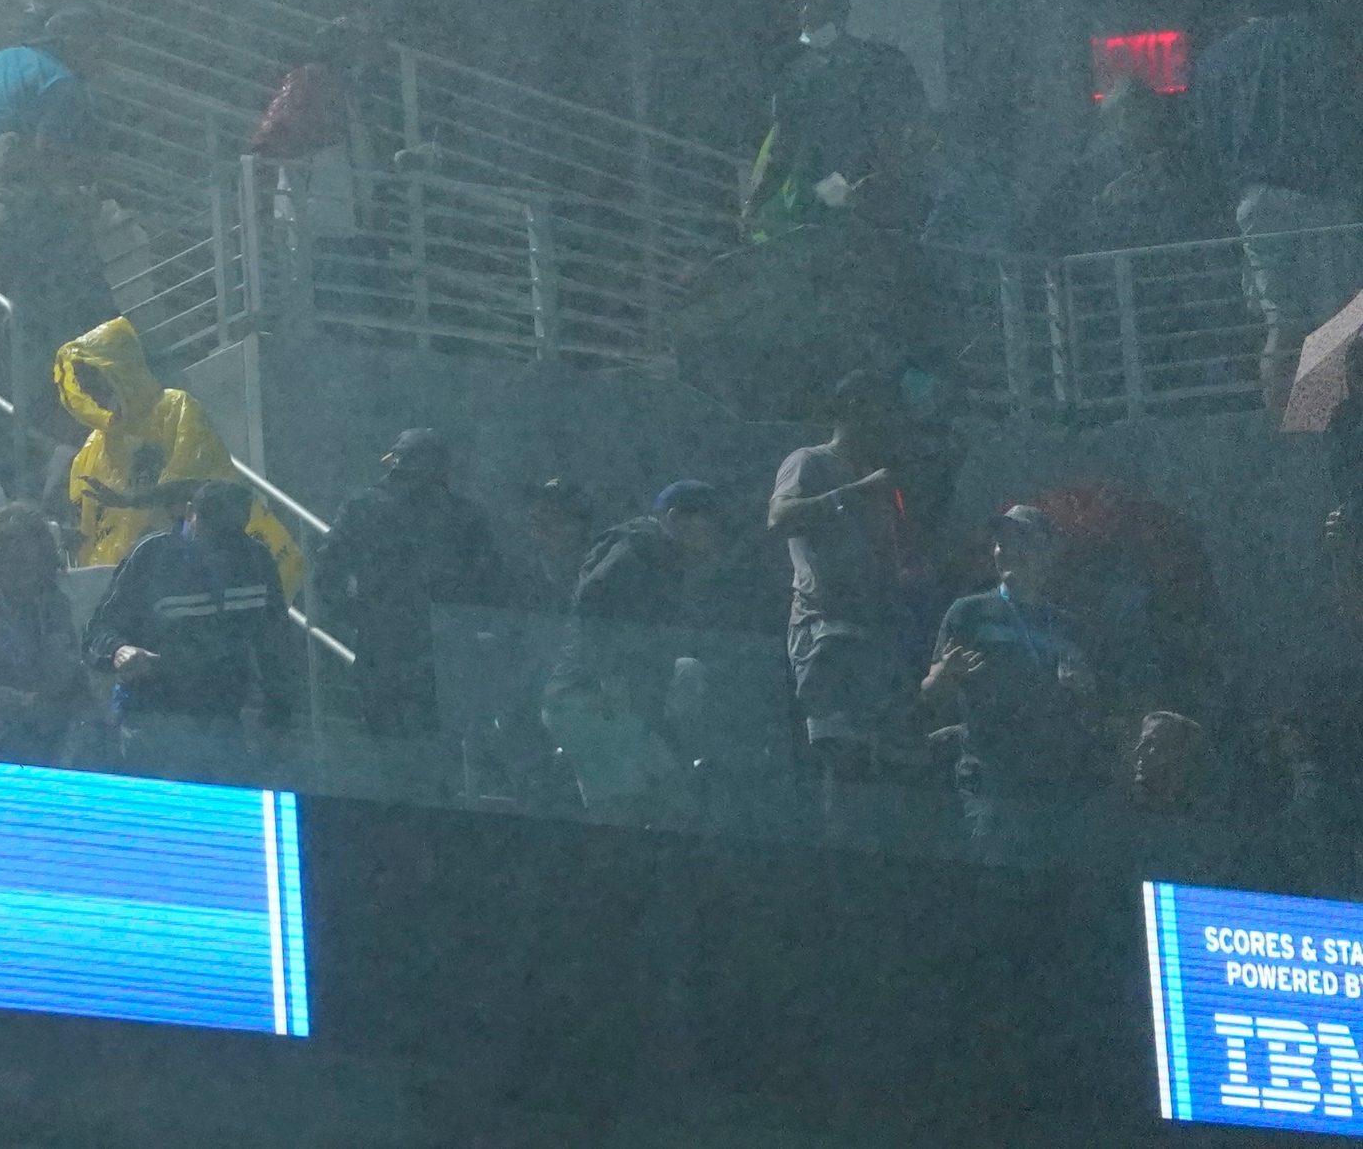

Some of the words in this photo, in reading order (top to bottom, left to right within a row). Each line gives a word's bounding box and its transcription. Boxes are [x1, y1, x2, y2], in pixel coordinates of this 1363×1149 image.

[1205, 927, 1295, 960] SCORES
[1301, 936, 1318, 962] &
[1323, 939, 1363, 966] STA
[1226, 961, 1338, 996] POWERED
[1345, 972, 1363, 999] B
